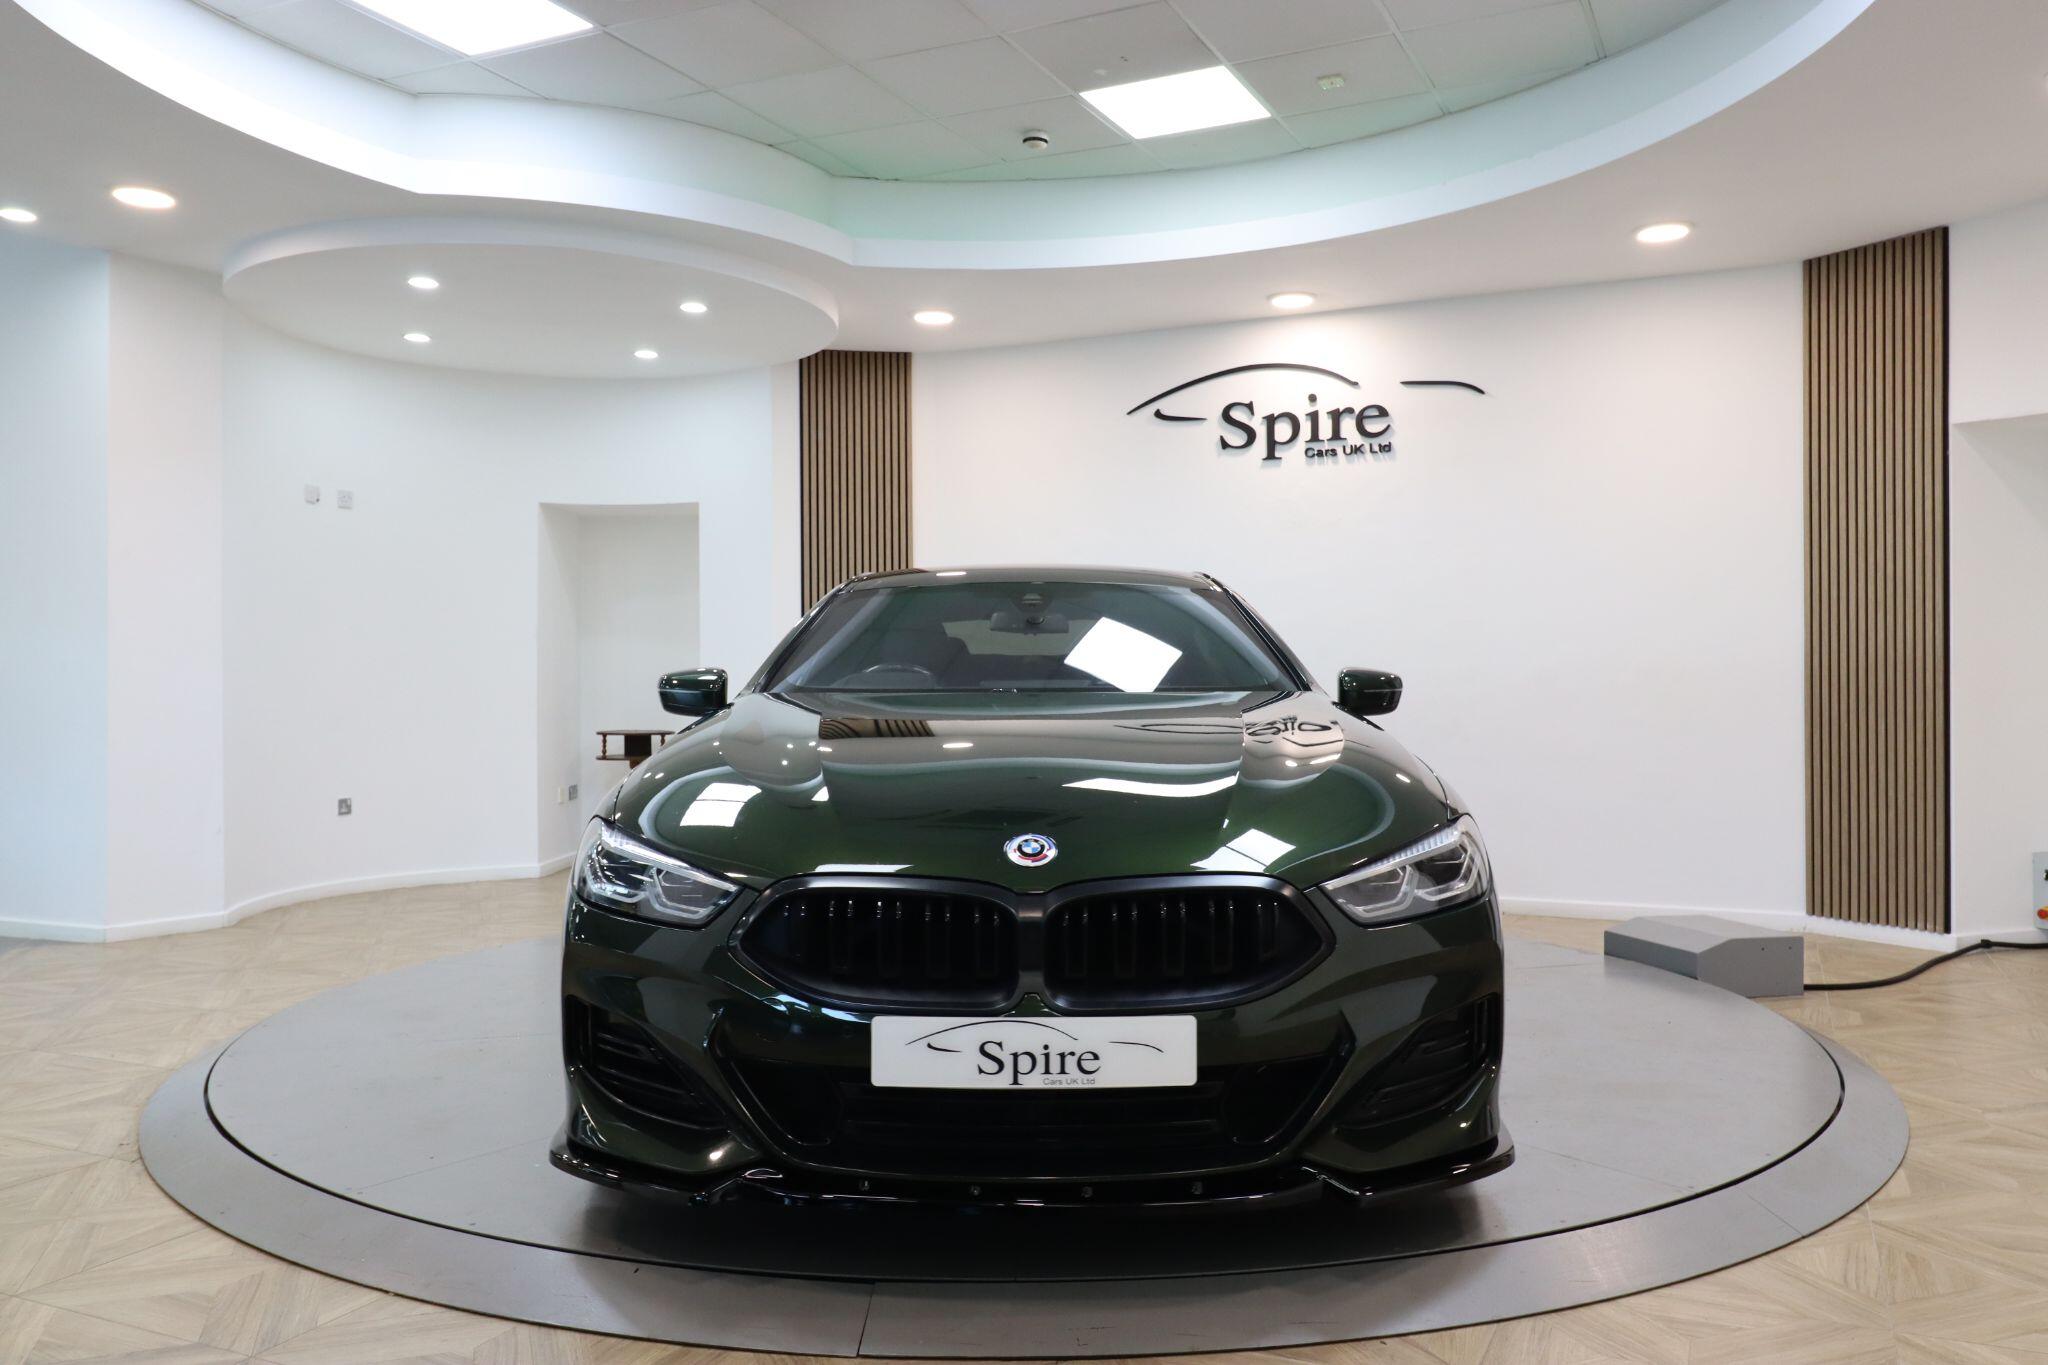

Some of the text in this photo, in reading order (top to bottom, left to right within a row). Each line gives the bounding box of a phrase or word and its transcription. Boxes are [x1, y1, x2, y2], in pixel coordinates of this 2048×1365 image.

[1219, 393, 1391, 461] Spire
[1304, 441, 1392, 459] Cars UK Ltd
[977, 1040, 1101, 1086] Spire
[1042, 1077, 1096, 1086] Cars UK Ltd
